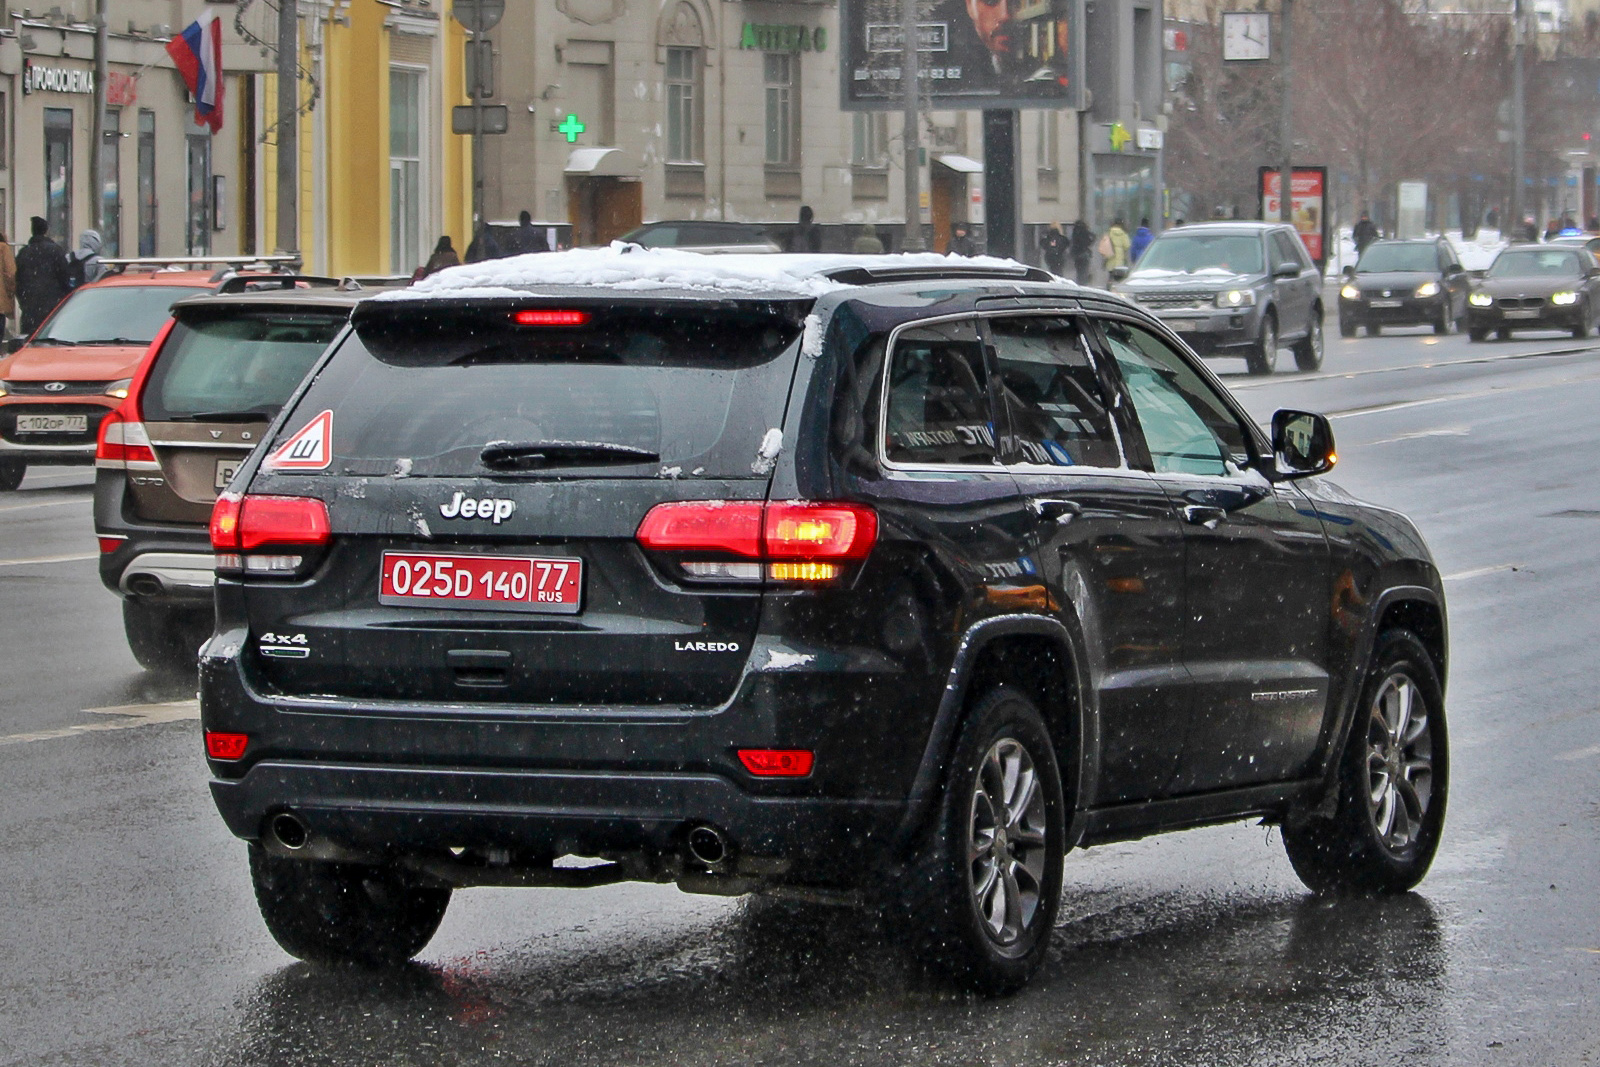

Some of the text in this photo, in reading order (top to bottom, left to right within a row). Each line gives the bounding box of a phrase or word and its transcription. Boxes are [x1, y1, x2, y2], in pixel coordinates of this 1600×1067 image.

[33, 66, 94, 94] ПРОФКОСМЕТИКА
[289, 440, 320, 459] Ш
[439, 491, 517, 524] Jeep
[536, 563, 569, 591] 77
[538, 591, 563, 602] RUS
[260, 632, 308, 645] 4x4
[674, 641, 740, 652] LAREDO
